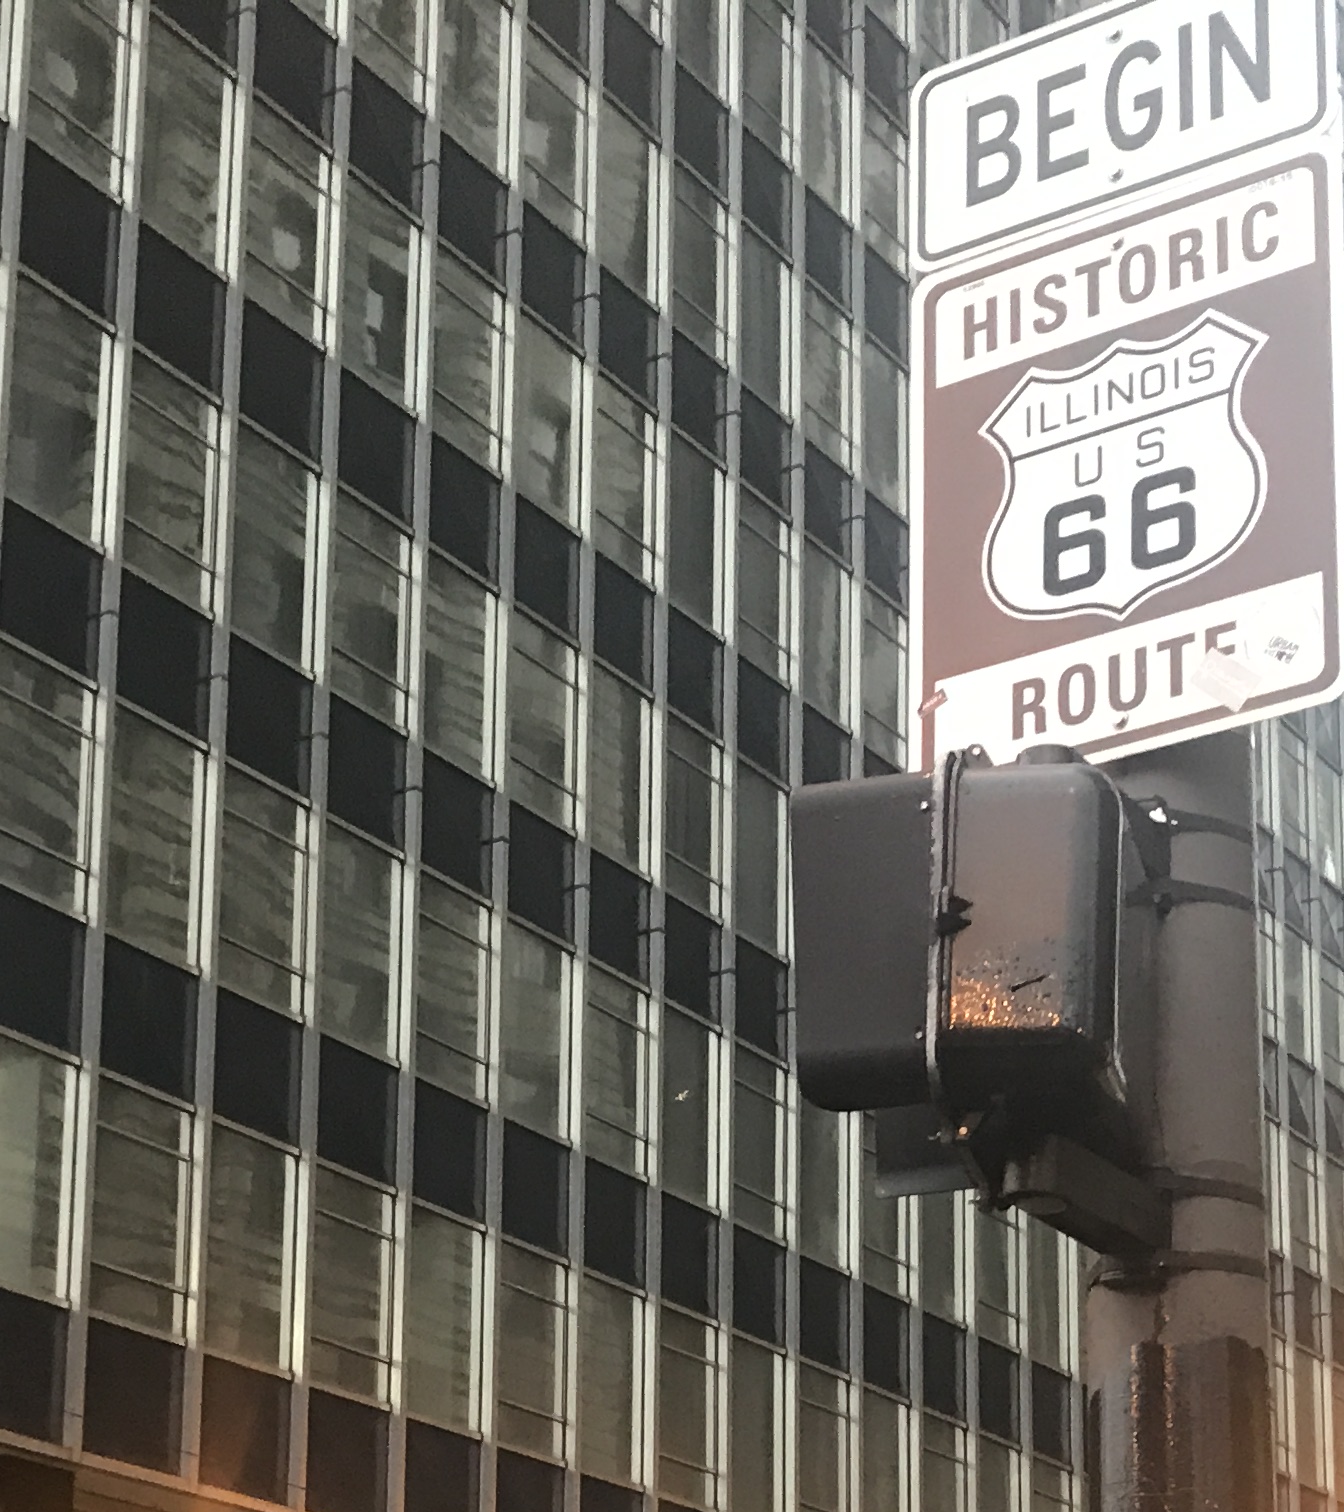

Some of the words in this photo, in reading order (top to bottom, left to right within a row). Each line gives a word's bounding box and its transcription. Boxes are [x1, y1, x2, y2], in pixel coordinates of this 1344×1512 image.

[965, 0, 1273, 208] BEGIN
[963, 200, 1280, 361] HISTORIC
[1025, 346, 1217, 440] ILLINOIS
[1072, 444, 1104, 489] U
[1135, 426, 1166, 469] S
[1042, 464, 1197, 598] 66
[1010, 619, 1240, 742] ROUTE
